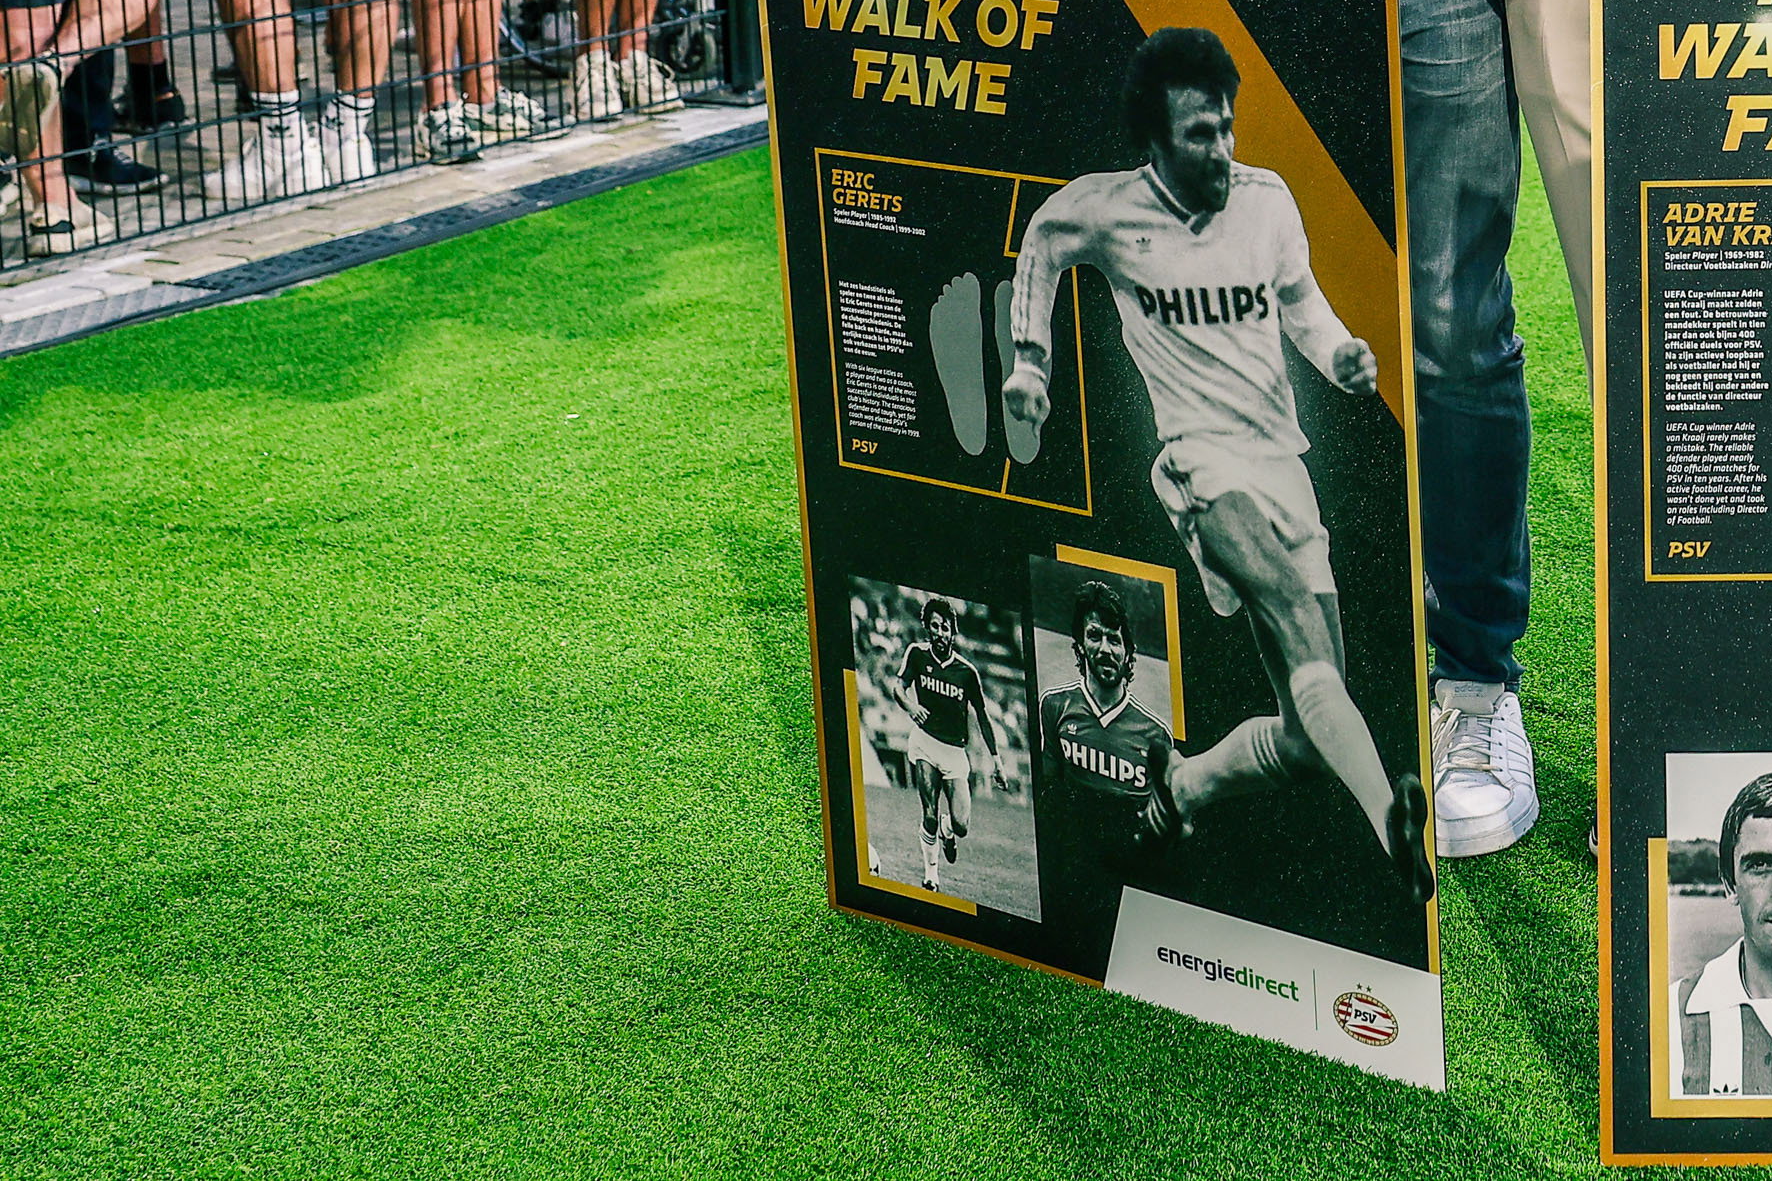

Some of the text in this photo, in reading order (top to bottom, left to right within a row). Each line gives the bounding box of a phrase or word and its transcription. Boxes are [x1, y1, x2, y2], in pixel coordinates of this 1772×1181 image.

[852, 48, 1012, 115] FAME
[831, 169, 875, 190] ERIC
[832, 188, 903, 212] GERETS
[833, 207, 897, 223] Speler Player 1985-1992
[1663, 202, 1758, 224] ADRIE
[834, 217, 864, 227] Hoofdcoach
[865, 221, 878, 229] Head
[879, 223, 895, 231] Coach
[1665, 225, 1725, 246] VAN
[1664, 251, 1764, 262] Speler Player 1969-1982
[1665, 261, 1702, 270] Directeur
[1704, 260, 1759, 270] Voetbalzaken
[1664, 289, 1763, 300] UEFA Cup-winnaar Adrie
[1134, 283, 1269, 325] PHILIPS
[1681, 300, 1705, 310] Kraaij
[1707, 300, 1733, 308] maakt
[1735, 299, 1762, 308] zelden
[1681, 310, 1701, 318] fout.
[1703, 310, 1713, 318] De
[1715, 310, 1767, 318] betrouwbare
[1665, 320, 1765, 330] mandekker speelt in tien
[1665, 330, 1755, 341] jaar dan ook bijna 400
[1665, 340, 1698, 349] officiële
[1700, 340, 1722, 348] duels
[1744, 340, 1762, 348] PSV.
[1665, 350, 1764, 361] Na zijn actieve loopbaan
[1665, 361, 1677, 369] als
[1679, 361, 1720, 369] voetballer
[1722, 360, 1737, 369] had
[1739, 360, 1750, 370] hij
[1665, 373, 1680, 381] nog
[1682, 373, 1702, 381] geen
[1703, 373, 1732, 381] genoeg
[1665, 381, 1769, 391] bekleedt hij onder andere
[1665, 392, 1675, 400] de
[1677, 392, 1707, 400] functie
[1725, 391, 1762, 399] directeur
[1665, 402, 1724, 410] voetbalzaken.
[1666, 422, 1755, 433] UEFA Cup winner Adrie
[1682, 433, 1705, 443] Kraaij
[1707, 432, 1729, 443] rarely
[1730, 432, 1756, 441] makes
[852, 438, 878, 455] PSV
[1673, 443, 1706, 451] mistake.
[1708, 443, 1723, 451] The
[1725, 443, 1754, 451] reliable
[1666, 453, 1754, 464] defender played nearly
[1666, 463, 1760, 474] 400 official matches for
[1666, 474, 1767, 484] PSV in ten years. After his
[1666, 485, 1690, 493] active
[1691, 484, 1723, 495] football
[1751, 484, 1761, 492] he
[1667, 494, 1765, 505] wasn't done yet and took
[1679, 505, 1697, 514] roles
[1699, 505, 1735, 515] including
[1737, 504, 1768, 513] Director
[1667, 516, 1712, 526] of Football.
[1668, 541, 1711, 558] PSV
[920, 674, 965, 702] PHILIPS
[1060, 737, 1147, 789] PHILIPS
[1157, 946, 1299, 1002] energiedirect
[1353, 1008, 1378, 1025] PSV
